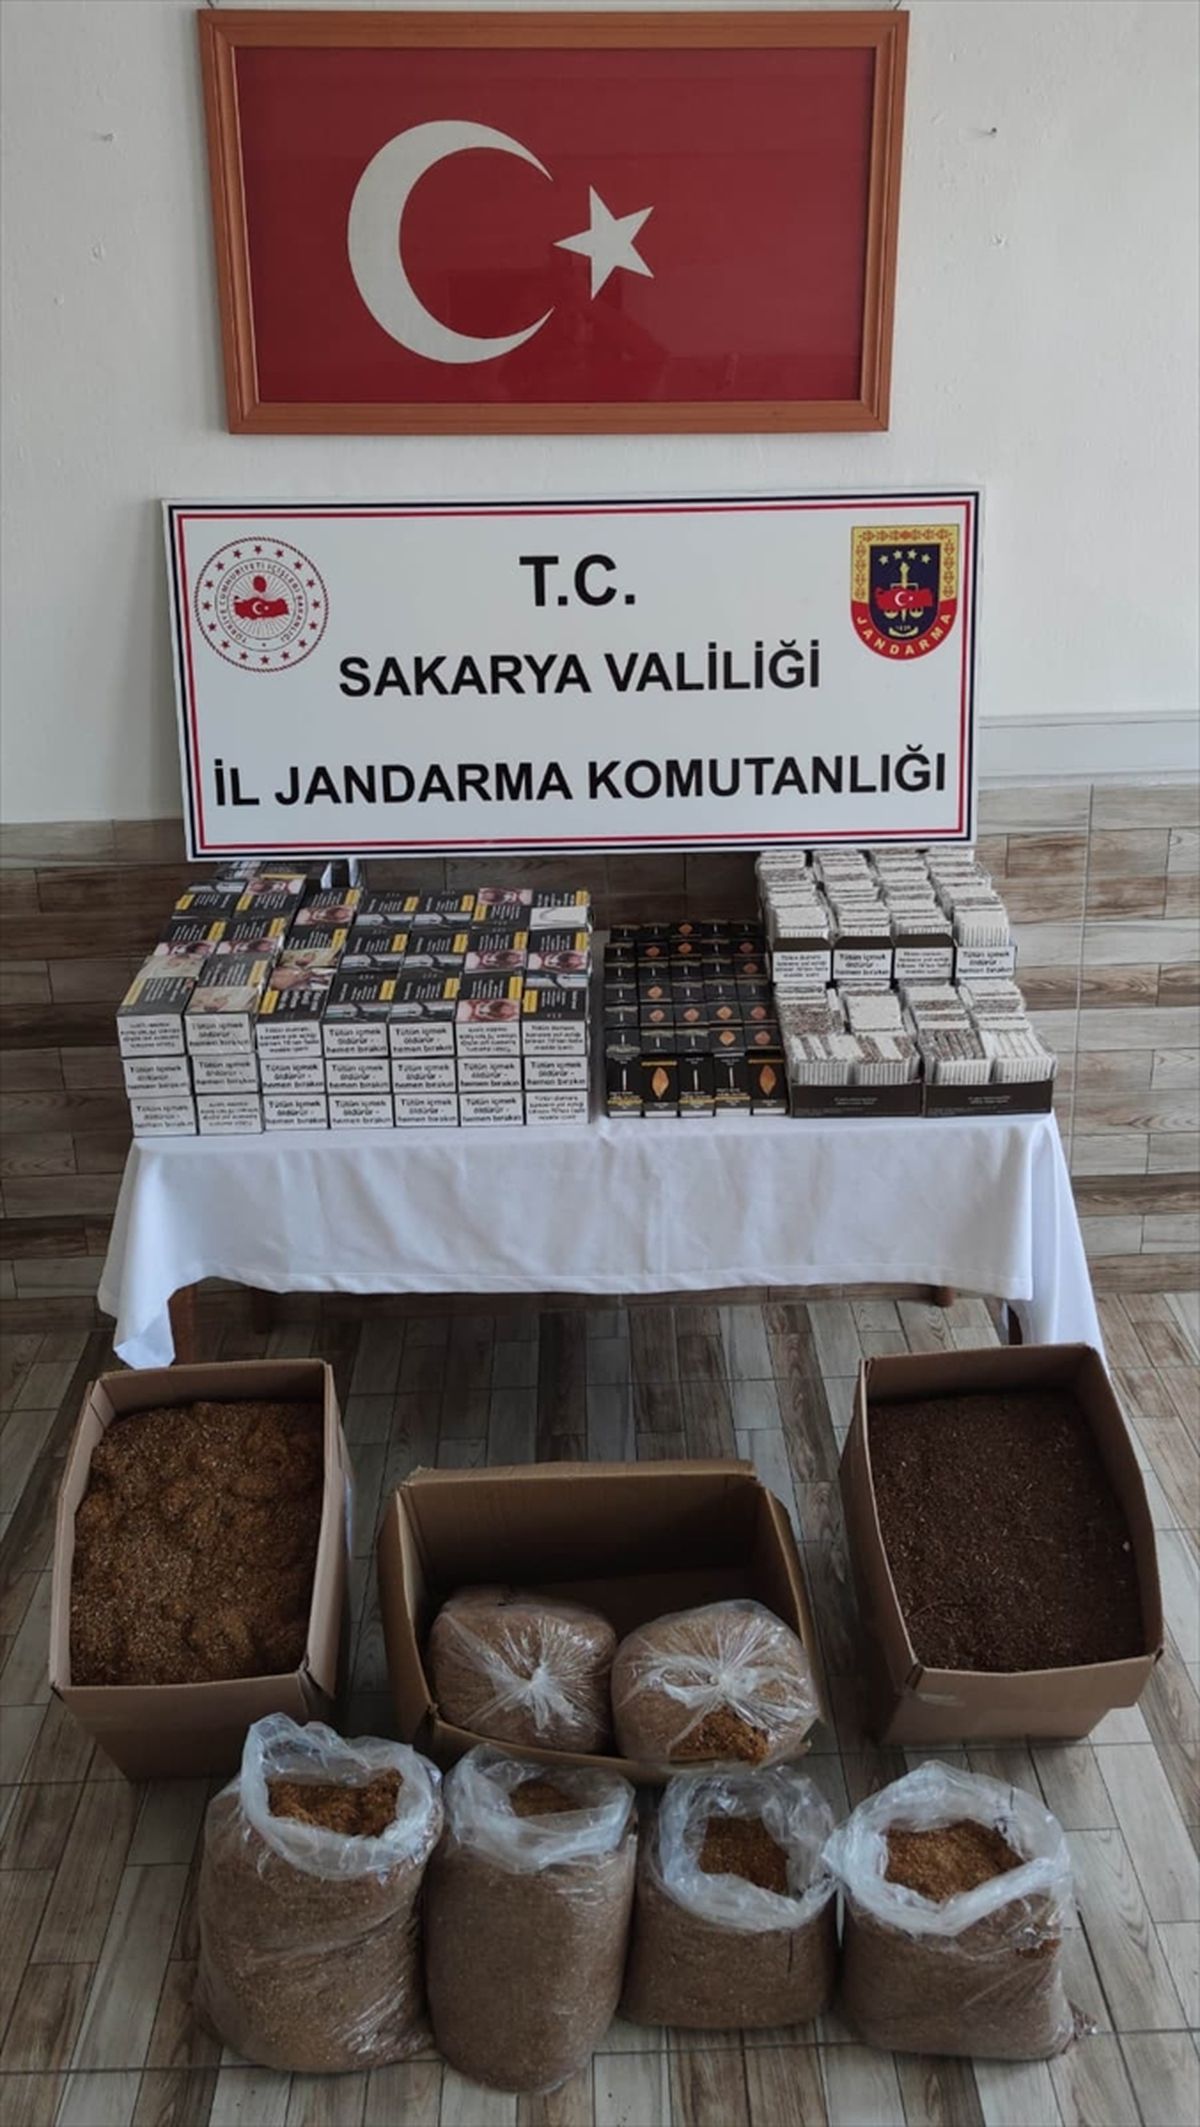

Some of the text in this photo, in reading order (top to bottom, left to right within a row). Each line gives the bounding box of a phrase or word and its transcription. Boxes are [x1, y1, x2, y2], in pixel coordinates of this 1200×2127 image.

[519, 554, 635, 607] T.C.
[856, 613, 951, 656] JANDARMA
[339, 638, 820, 697] SAKARYA VALİLİĞİ
[214, 744, 946, 806] İL JANDARMA KOMUTANLIĞI
